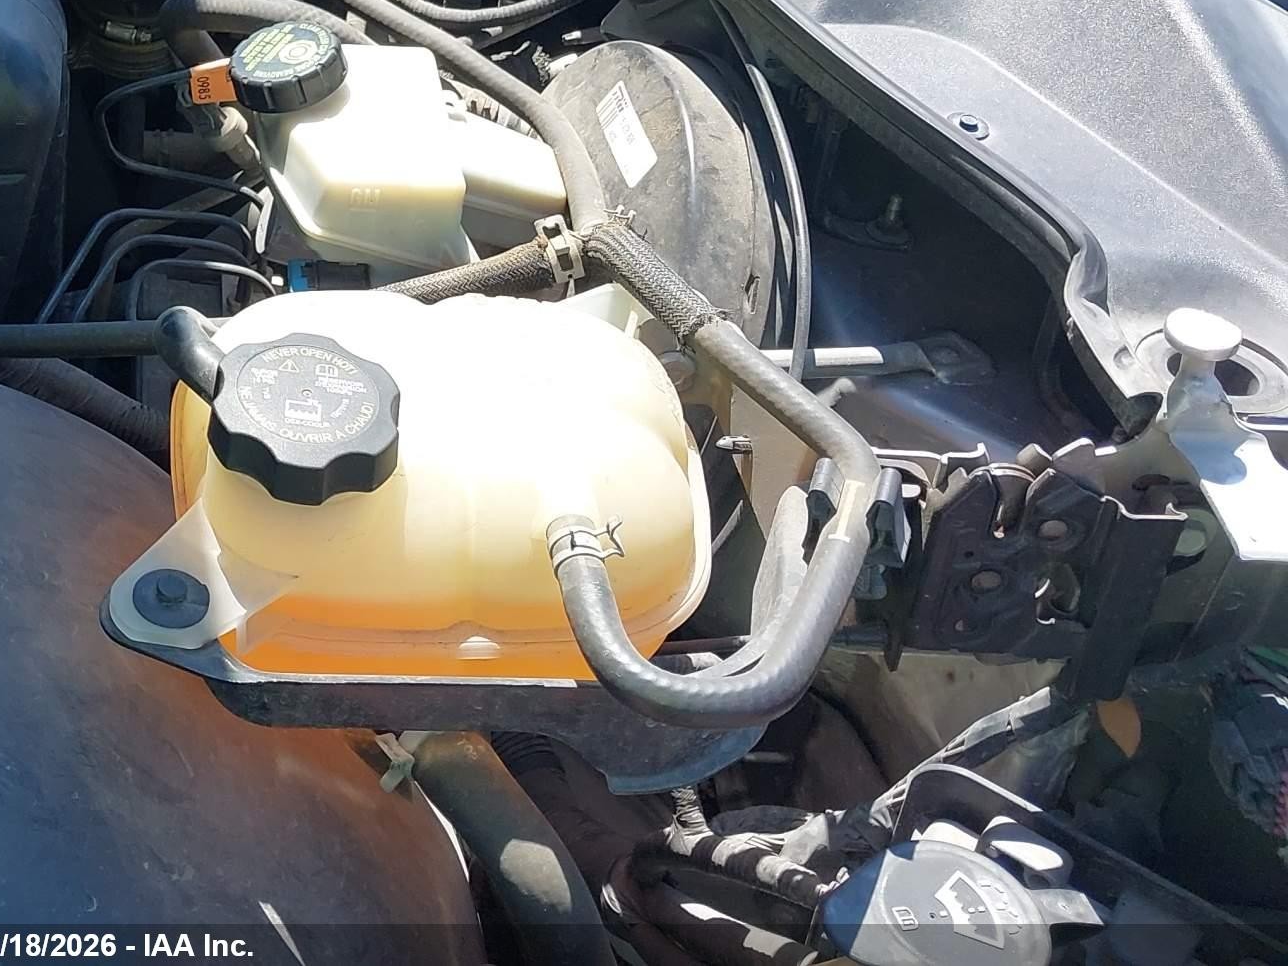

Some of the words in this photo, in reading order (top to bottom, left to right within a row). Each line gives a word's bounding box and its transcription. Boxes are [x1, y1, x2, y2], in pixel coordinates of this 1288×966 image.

[261, 347, 299, 362] NEVER
[300, 347, 332, 361] OPEN
[239, 385, 253, 400] NE
[279, 428, 333, 443] OUVRIR
